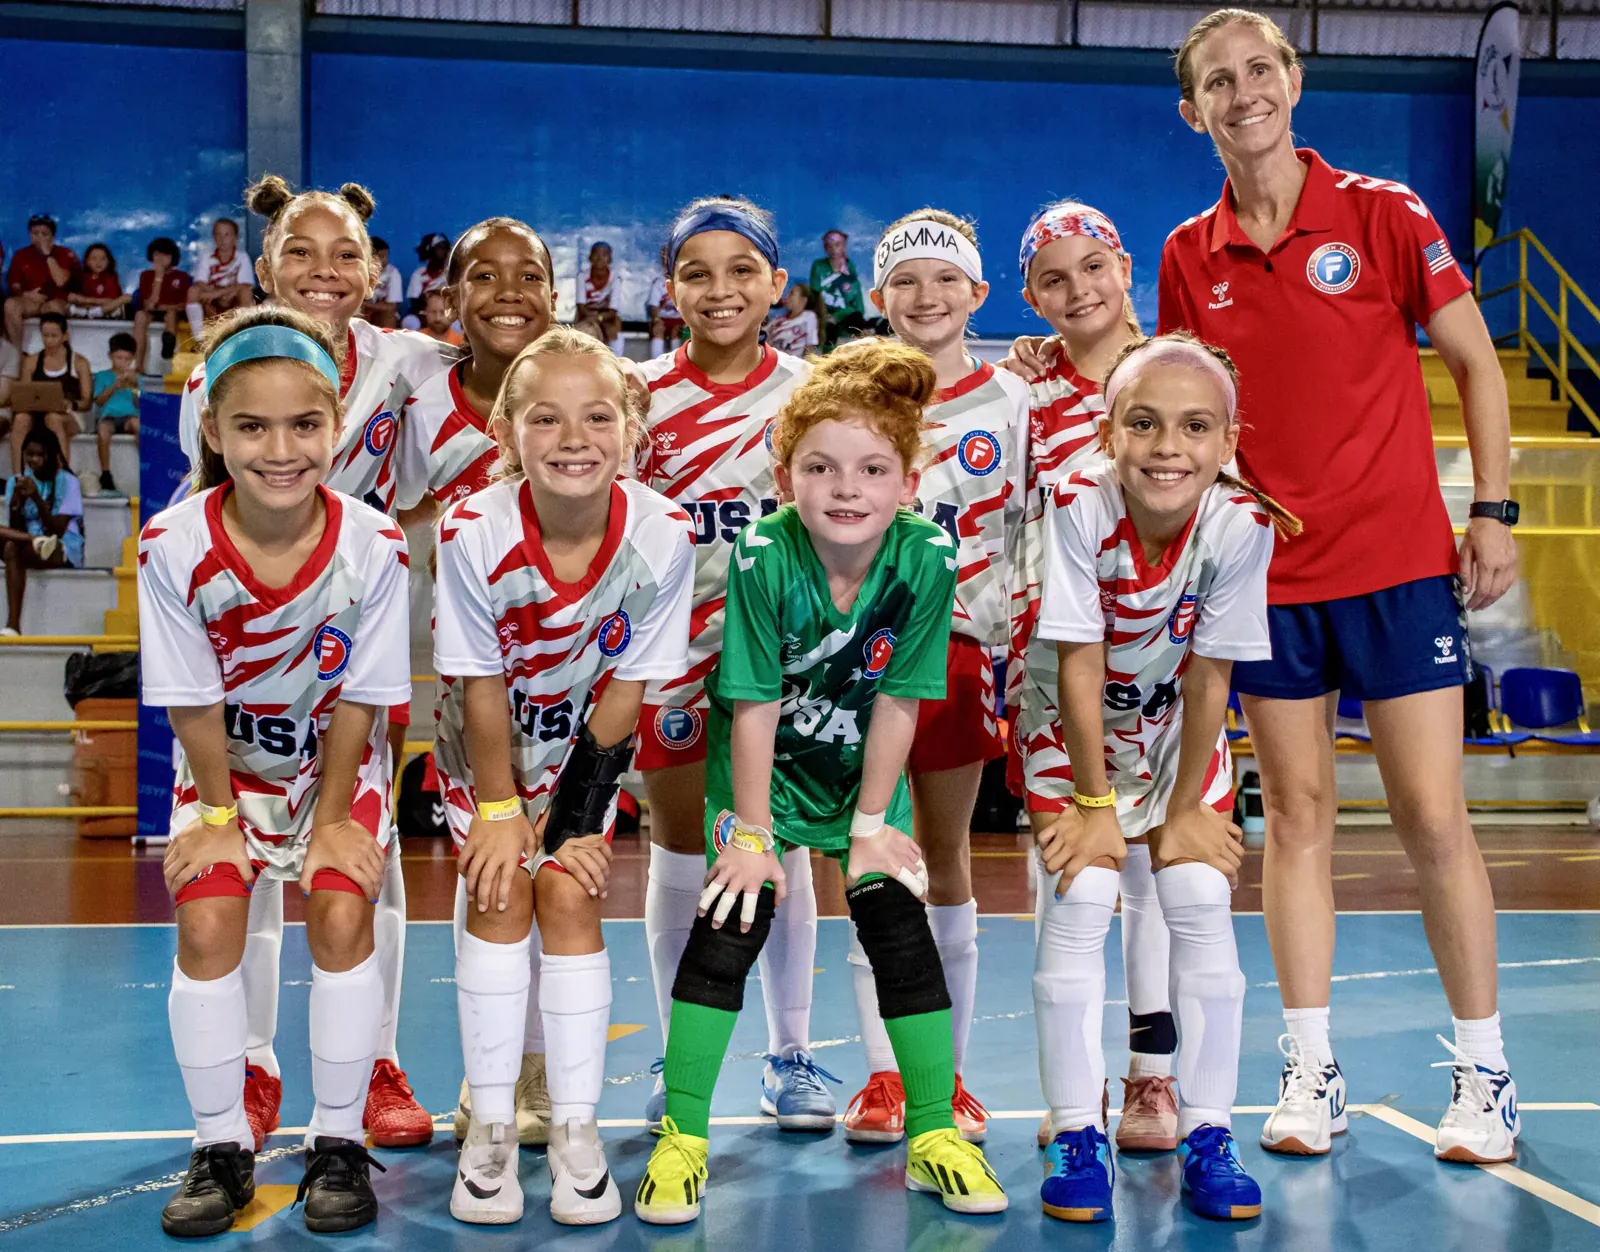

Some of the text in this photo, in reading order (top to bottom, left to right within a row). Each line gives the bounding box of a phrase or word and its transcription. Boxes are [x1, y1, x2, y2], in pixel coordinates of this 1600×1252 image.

[892, 227, 960, 254] EMMA
[1324, 255, 1344, 282] F
[1339, 245, 1358, 269] FUTSAL
[1207, 296, 1234, 310] hummel
[377, 420, 391, 448] F
[965, 431, 989, 439] YOUTH
[990, 436, 1000, 462] FUTSAL
[656, 447, 682, 456] hummel
[970, 440, 990, 463] F
[681, 498, 779, 545] US
[319, 639, 337, 665] F
[1433, 653, 1458, 665] hummel
[1103, 677, 1177, 718] SA
[668, 713, 685, 739] F
